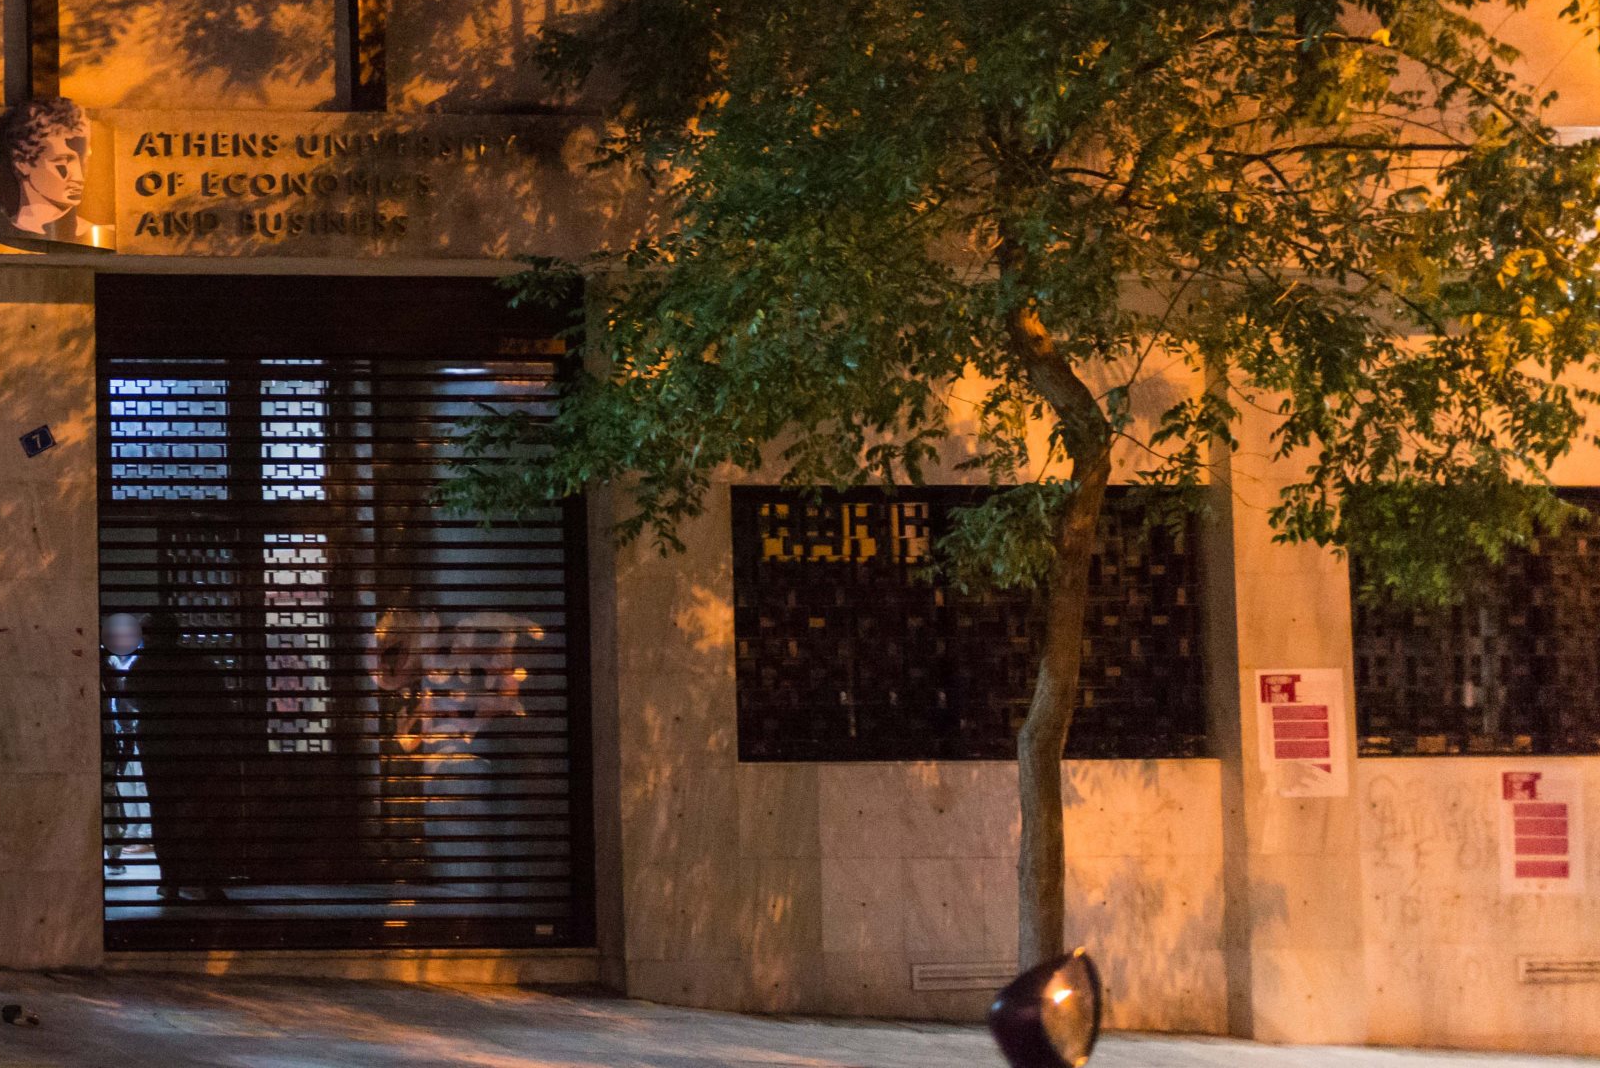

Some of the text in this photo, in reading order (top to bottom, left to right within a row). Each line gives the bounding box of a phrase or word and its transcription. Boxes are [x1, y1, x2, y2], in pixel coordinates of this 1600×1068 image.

[133, 132, 280, 158] ATHENS
[134, 171, 431, 200] OF ECONOMICS
[134, 211, 409, 239] AND BUSINESS
